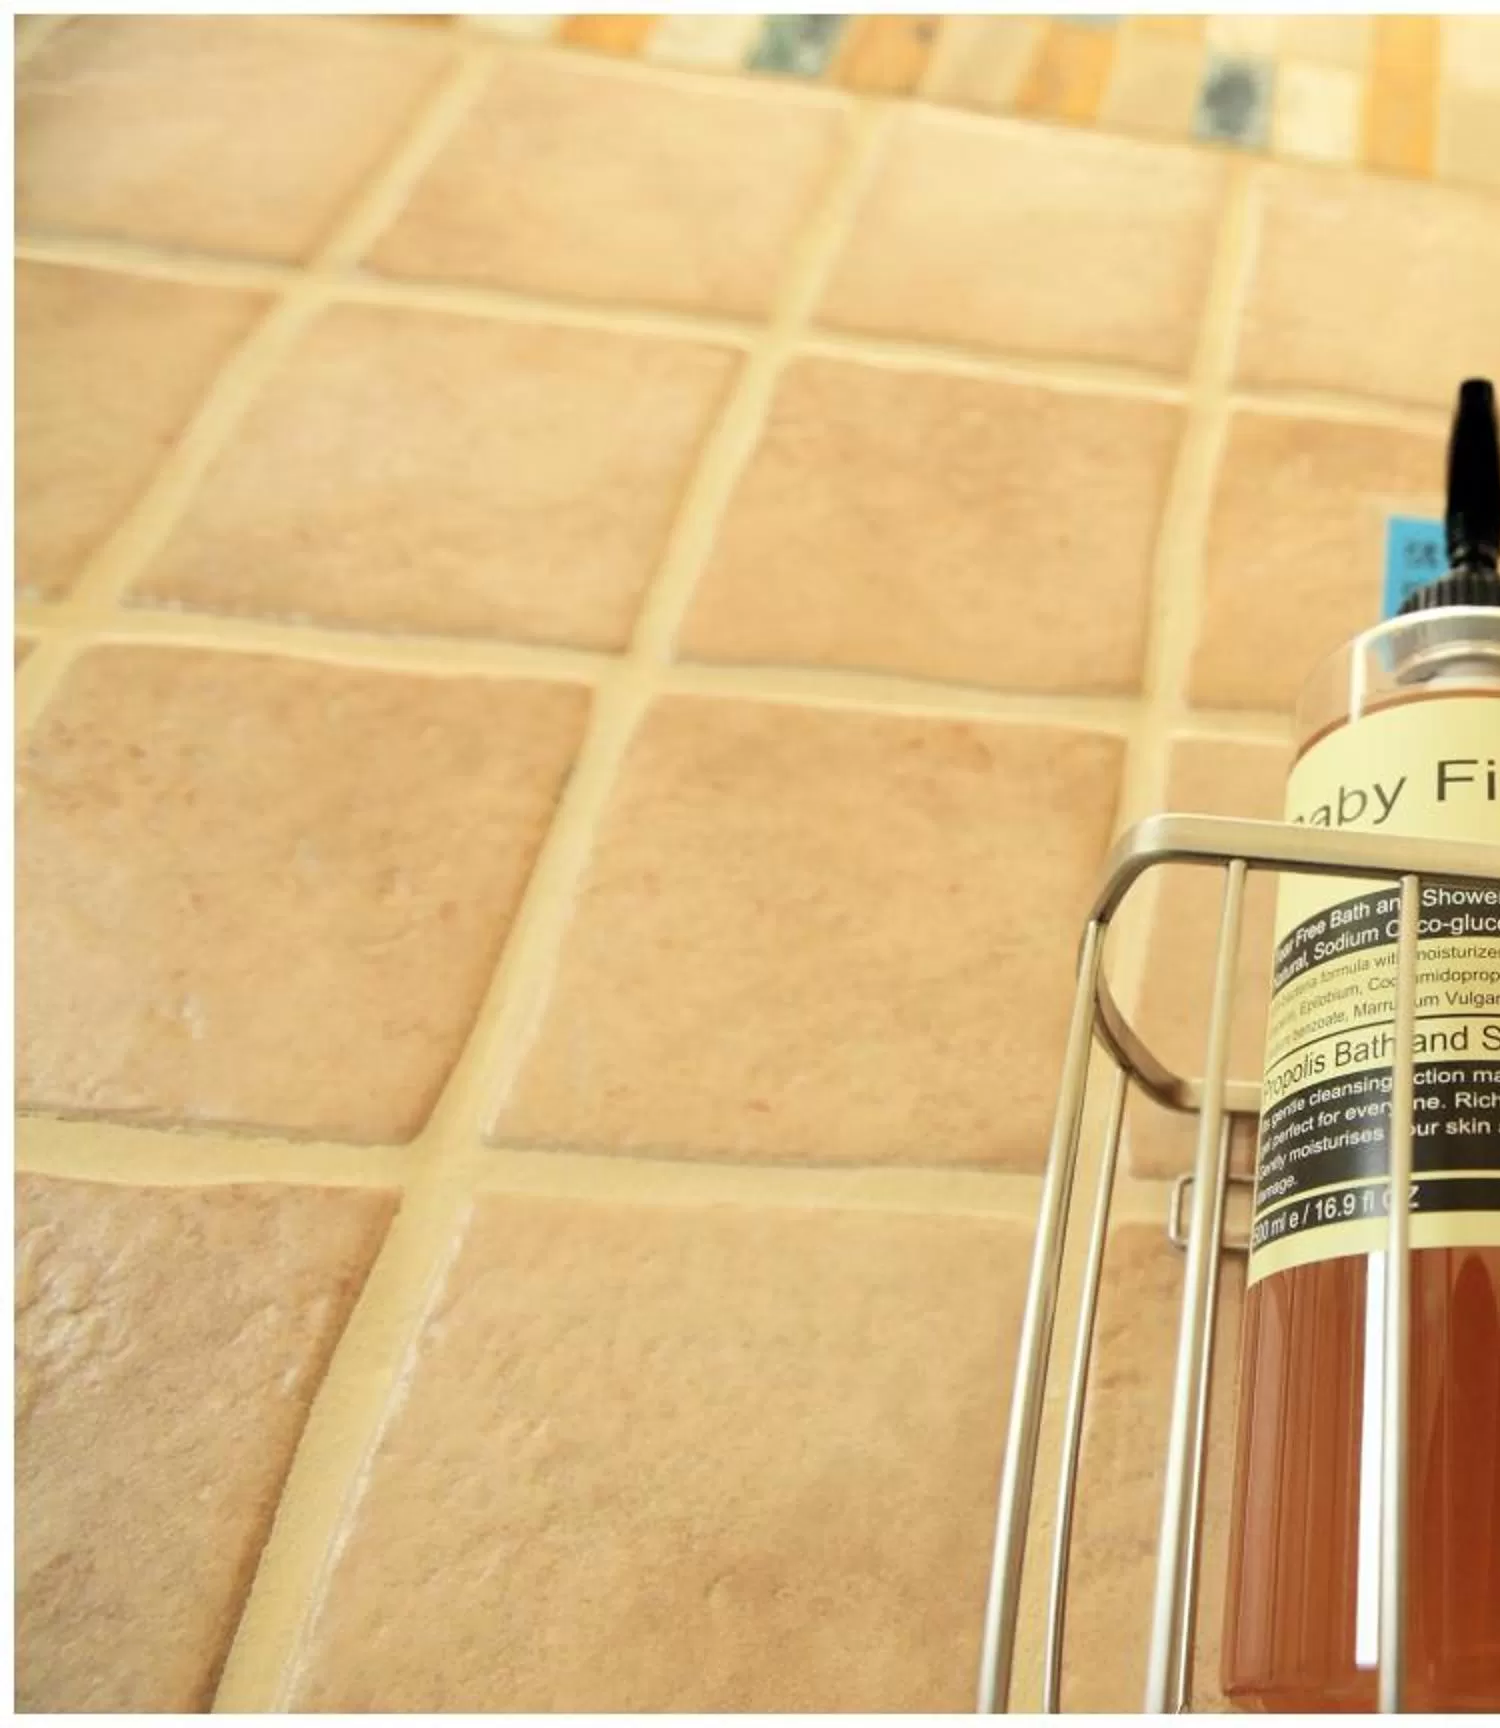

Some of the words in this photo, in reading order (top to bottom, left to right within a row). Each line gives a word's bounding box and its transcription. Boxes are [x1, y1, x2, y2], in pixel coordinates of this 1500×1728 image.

[1290, 775, 1408, 828] aby
[1295, 920, 1327, 947] Free
[1330, 902, 1371, 928] Bath
[1376, 896, 1402, 915] an
[1313, 927, 1380, 960] Sodium
[1374, 952, 1397, 967] wit
[1353, 995, 1440, 1019] Marruum
[1335, 1031, 1397, 1067] Bath
[1411, 1025, 1469, 1053] and
[1309, 1075, 1394, 1106] cleansing
[1413, 1068, 1465, 1086] ction
[1272, 1117, 1314, 1151] perfect
[1317, 1110, 1341, 1129] for
[1345, 1097, 1447, 1122] everne.
[1289, 1126, 1385, 1163] moisturises
[1445, 1117, 1491, 1135] skin
[1271, 1211, 1286, 1236] ml
[1289, 1213, 1299, 1229] e
[1302, 1202, 1311, 1226] /
[1315, 1194, 1356, 1221] 16.9
